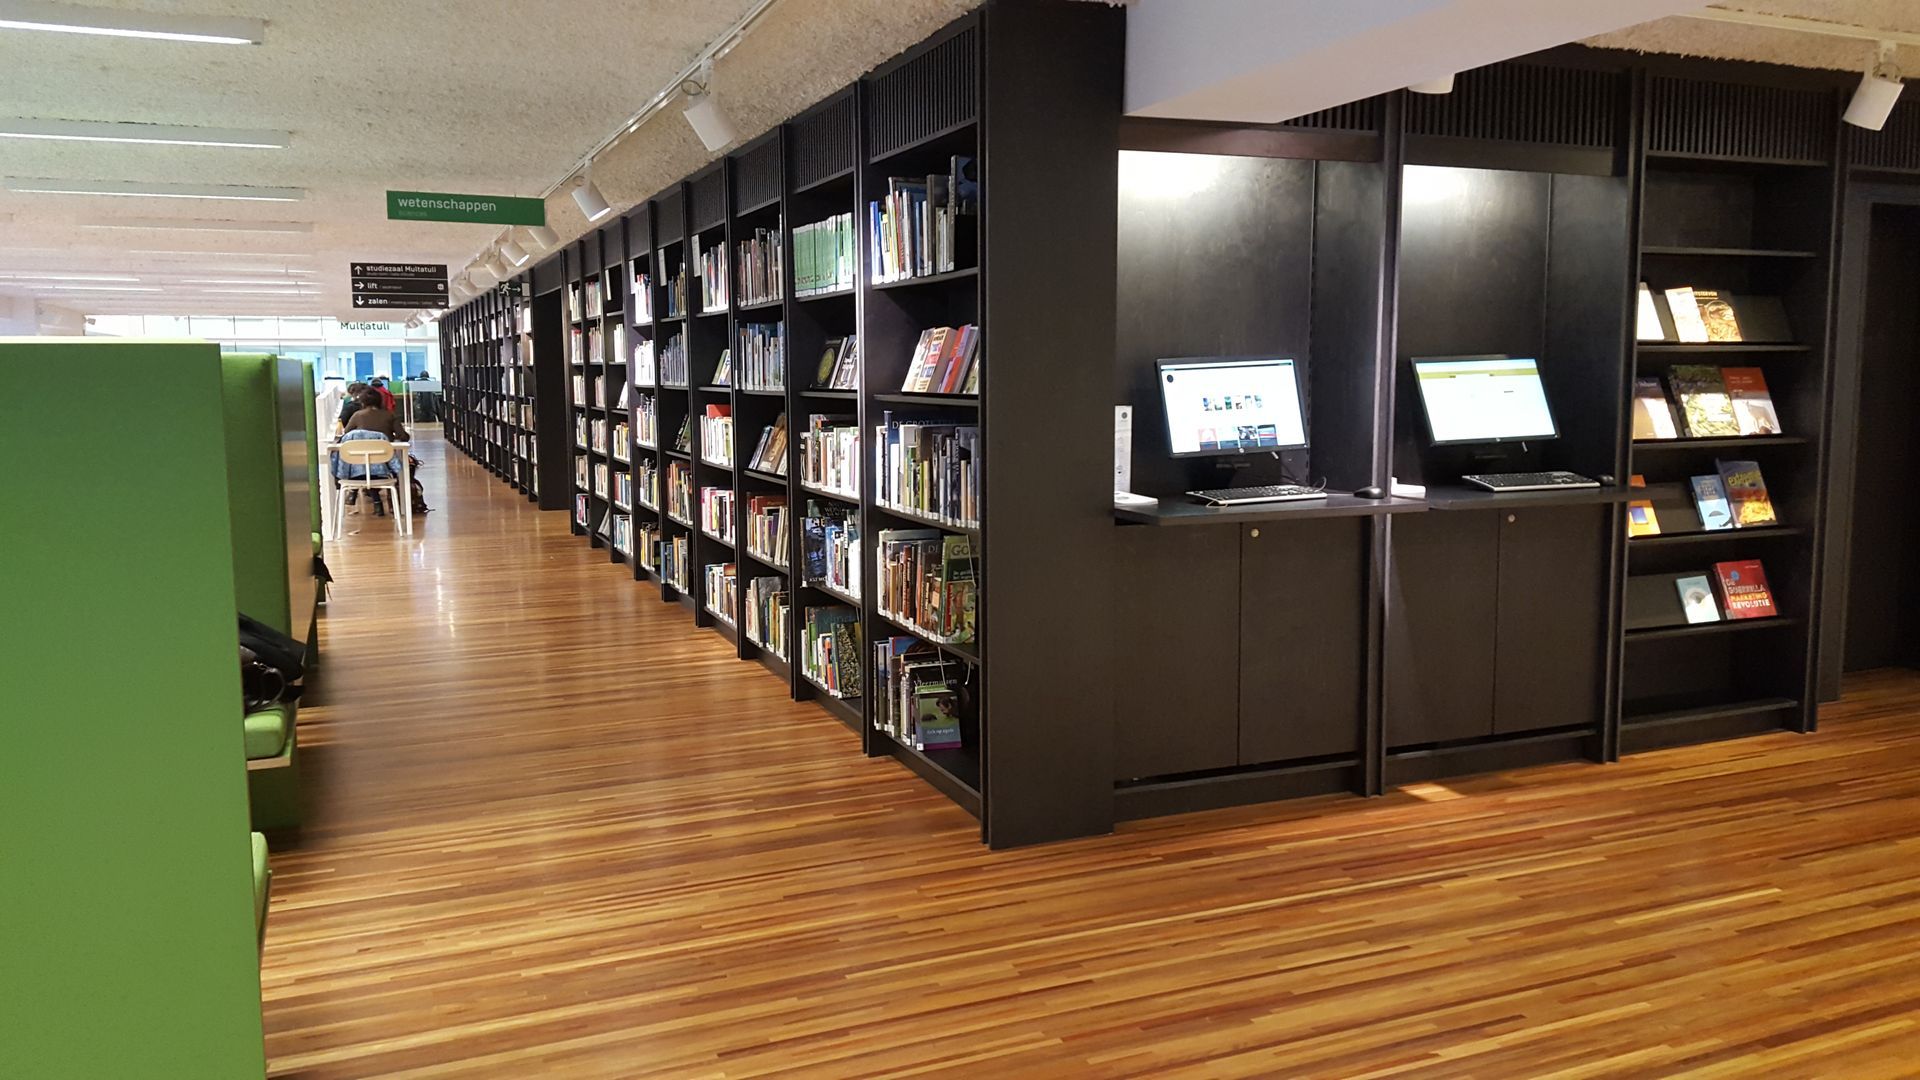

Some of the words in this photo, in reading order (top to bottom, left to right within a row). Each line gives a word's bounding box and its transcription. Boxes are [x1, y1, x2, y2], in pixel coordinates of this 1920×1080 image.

[397, 197, 497, 213] wetenschappen
[340, 321, 390, 330] Multatuli
[1732, 599, 1771, 609] REVOLUTIE
